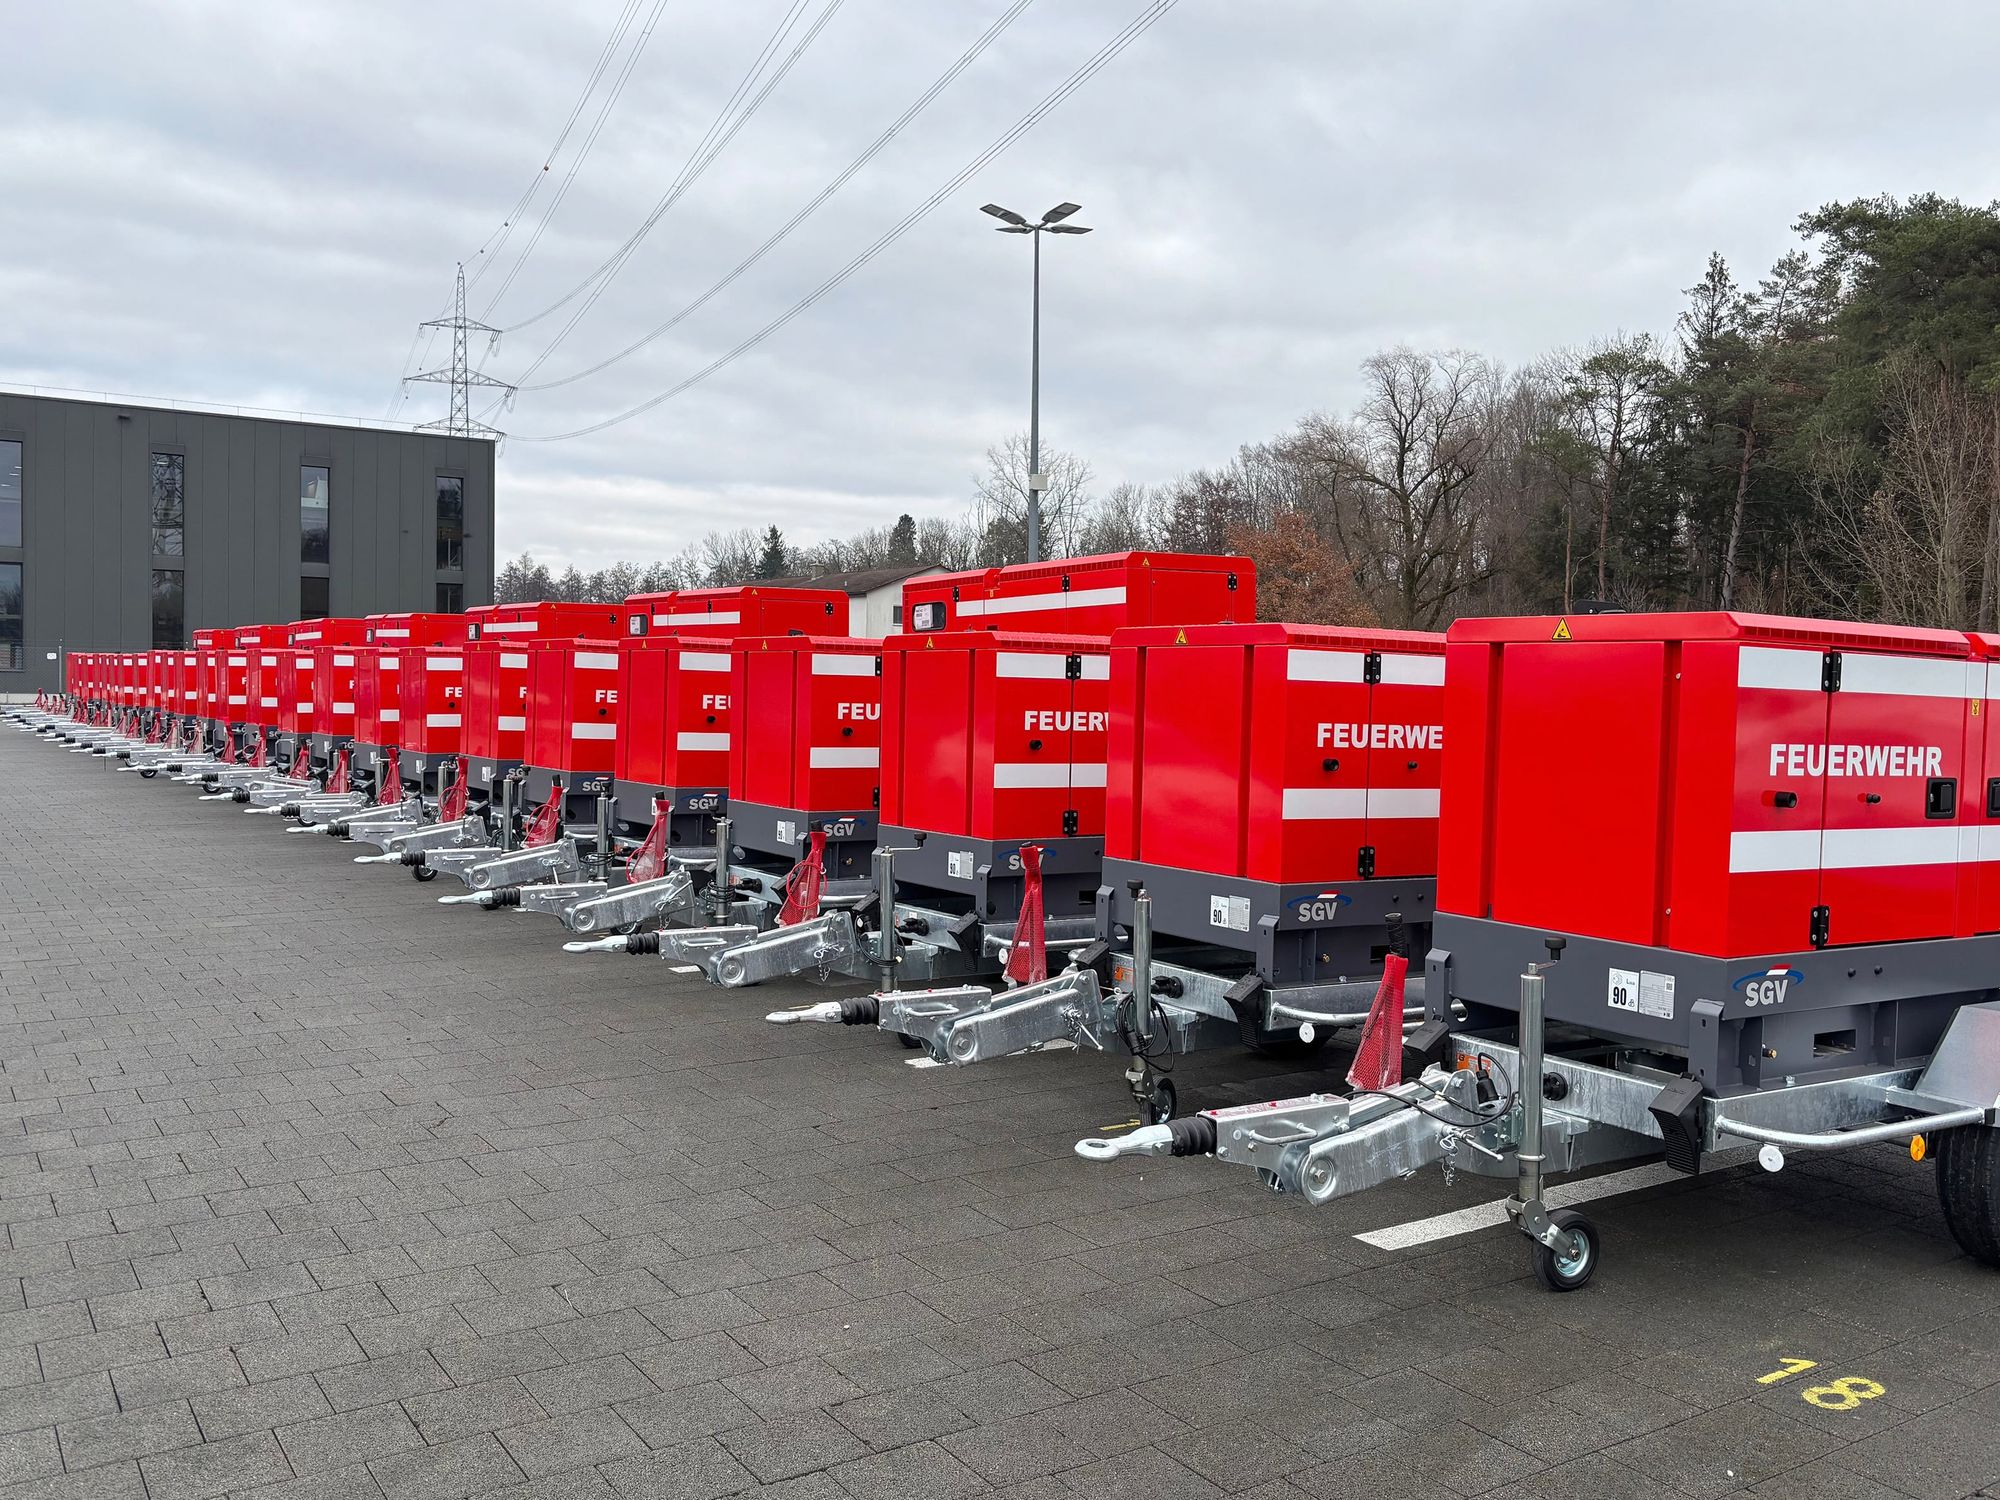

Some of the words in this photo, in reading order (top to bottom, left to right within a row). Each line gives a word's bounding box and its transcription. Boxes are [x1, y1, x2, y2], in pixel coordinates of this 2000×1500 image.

[702, 694, 731, 710] FE
[837, 702, 880, 720] FEU
[1024, 710, 1109, 732] FEUER
[1317, 722, 1444, 750] FEUERWE
[1769, 743, 1943, 777] FEUERWEHR
[823, 823, 855, 837] SGV
[1212, 908, 1222, 924] 90
[1297, 902, 1338, 922] SGV
[1612, 986, 1627, 1006] 90
[1744, 979, 1789, 1006] SGV
[1756, 1357, 1886, 1411] 18
